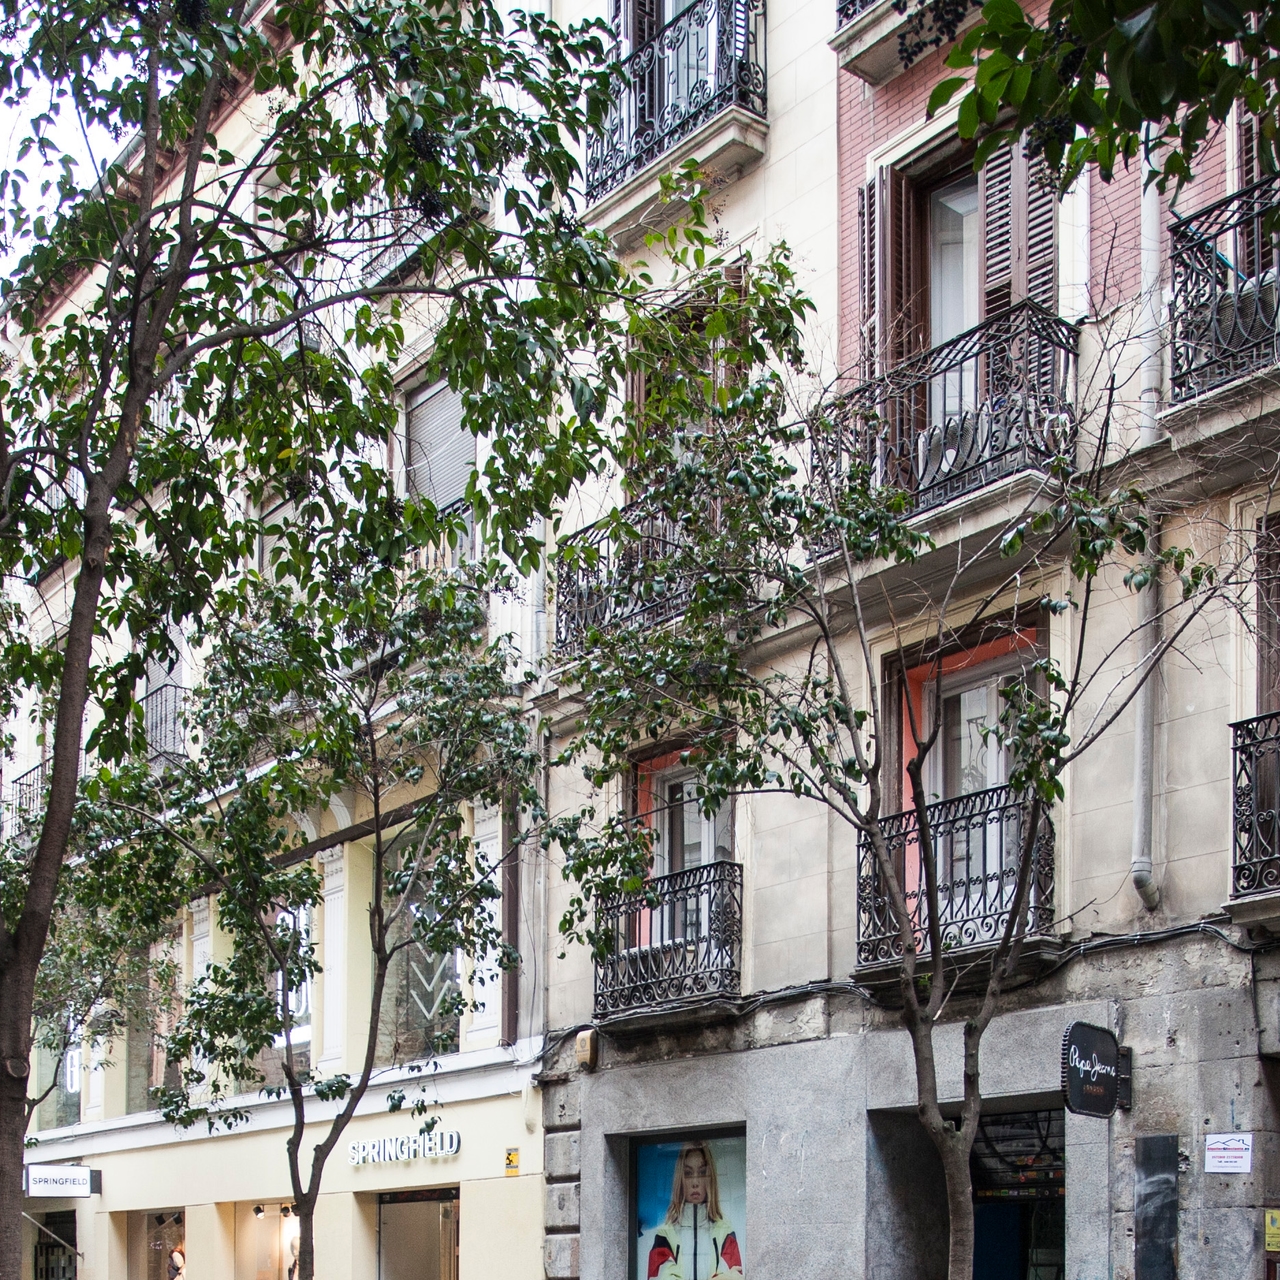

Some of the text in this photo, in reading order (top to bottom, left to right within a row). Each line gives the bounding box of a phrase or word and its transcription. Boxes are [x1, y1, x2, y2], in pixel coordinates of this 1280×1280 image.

[1069, 1045, 1116, 1082] Pepe Jeans
[348, 1130, 462, 1166] SPRINGFIELD
[32, 1177, 88, 1186] SPRINGFIELD
